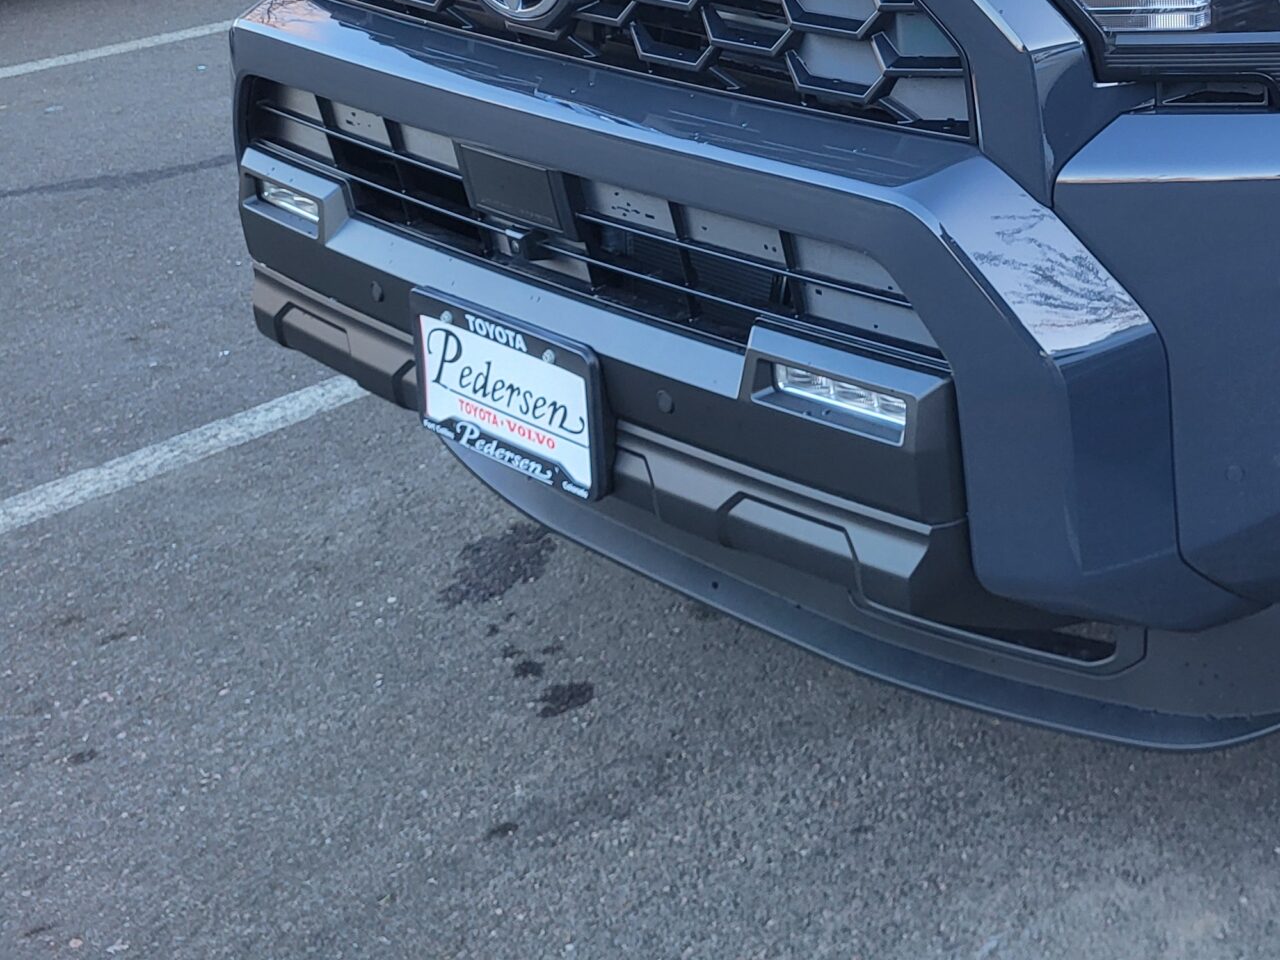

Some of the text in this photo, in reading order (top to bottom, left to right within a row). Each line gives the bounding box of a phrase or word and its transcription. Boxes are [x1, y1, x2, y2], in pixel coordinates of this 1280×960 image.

[464, 313, 527, 352] TOYOTA
[427, 327, 585, 434] Pedersen
[455, 421, 554, 480] Pedersen
[458, 399, 556, 450] TOYOTA VOLVO
